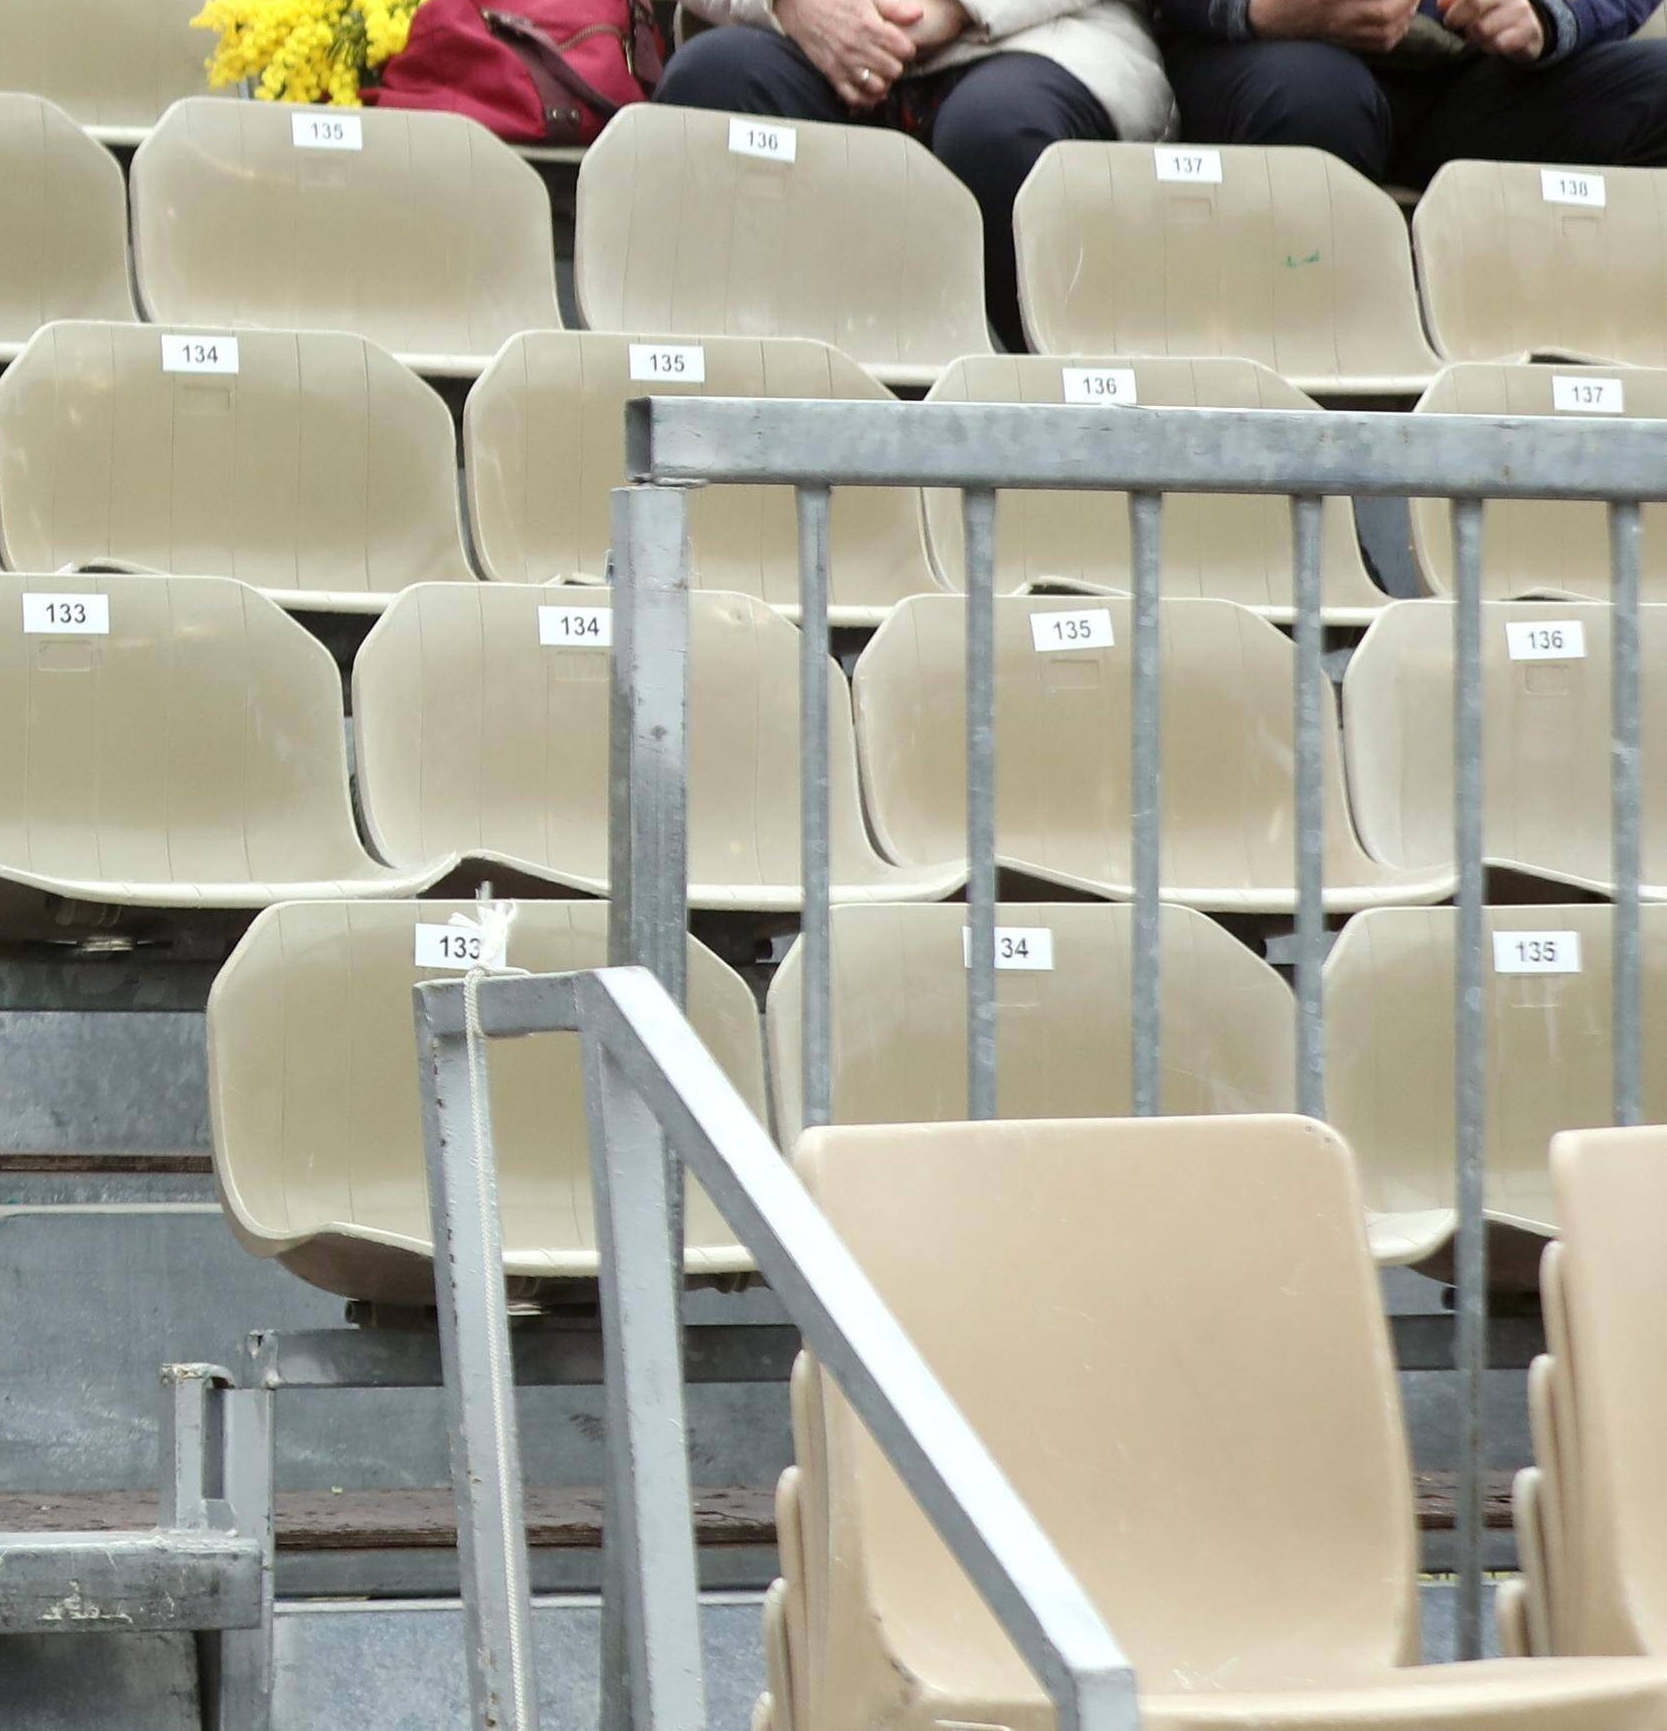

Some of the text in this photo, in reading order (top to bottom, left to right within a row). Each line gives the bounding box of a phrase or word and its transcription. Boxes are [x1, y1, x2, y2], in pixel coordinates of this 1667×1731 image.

[311, 121, 344, 141] 135
[747, 130, 778, 151] 136
[1173, 156, 1202, 174] 137
[1559, 179, 1588, 197] 138
[182, 344, 218, 364] 134
[650, 353, 685, 373] 135
[1082, 376, 1117, 395] 136
[1571, 385, 1603, 404] 137
[45, 602, 86, 624] 133
[560, 615, 599, 637] 134
[1053, 619, 1091, 641] 135
[1526, 630, 1563, 650] 136
[439, 935, 481, 960] 133
[1000, 936, 1029, 959] 34
[1515, 941, 1557, 963] 135
